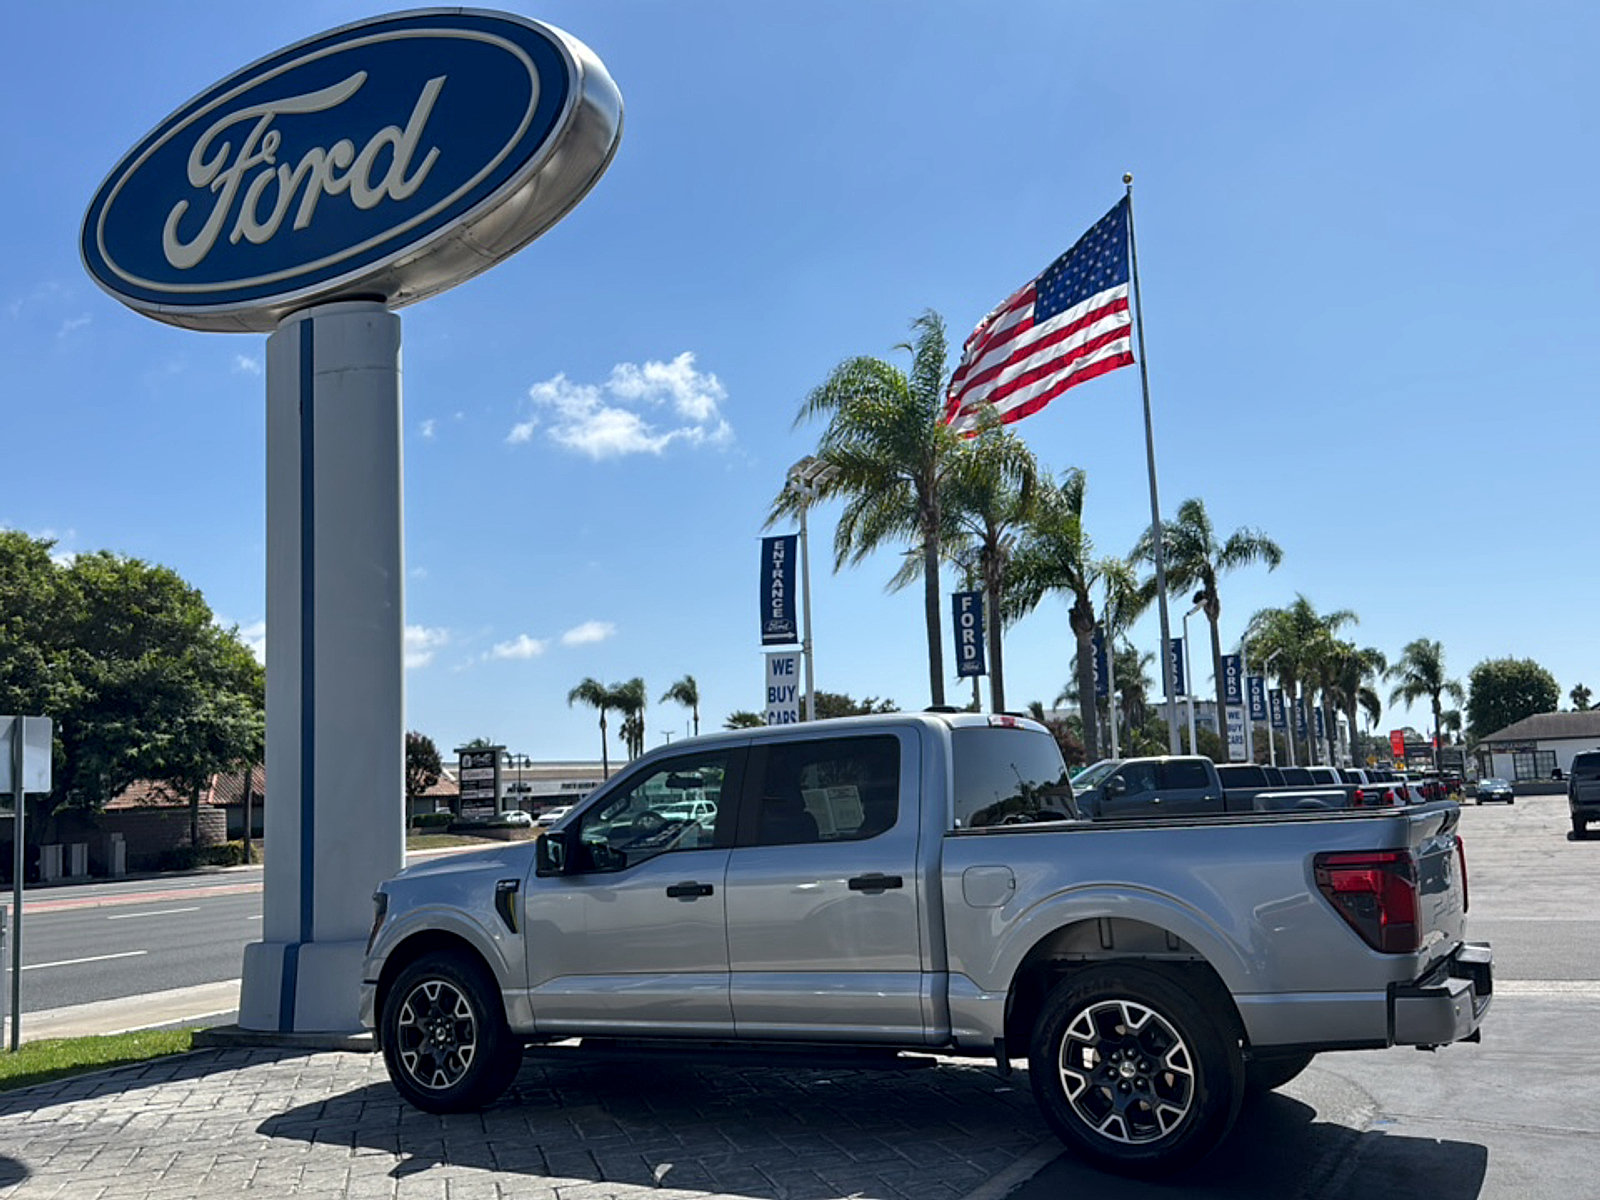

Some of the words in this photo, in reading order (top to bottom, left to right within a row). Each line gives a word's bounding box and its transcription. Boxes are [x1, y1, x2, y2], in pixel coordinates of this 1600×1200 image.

[162, 70, 447, 269] Ford
[772, 540, 785, 618] ENTRANCE
[961, 596, 976, 660] FORD
[772, 658, 794, 676] WE
[1226, 657, 1237, 695] FORD
[768, 685, 796, 703] BUY
[1251, 678, 1262, 711] FORD
